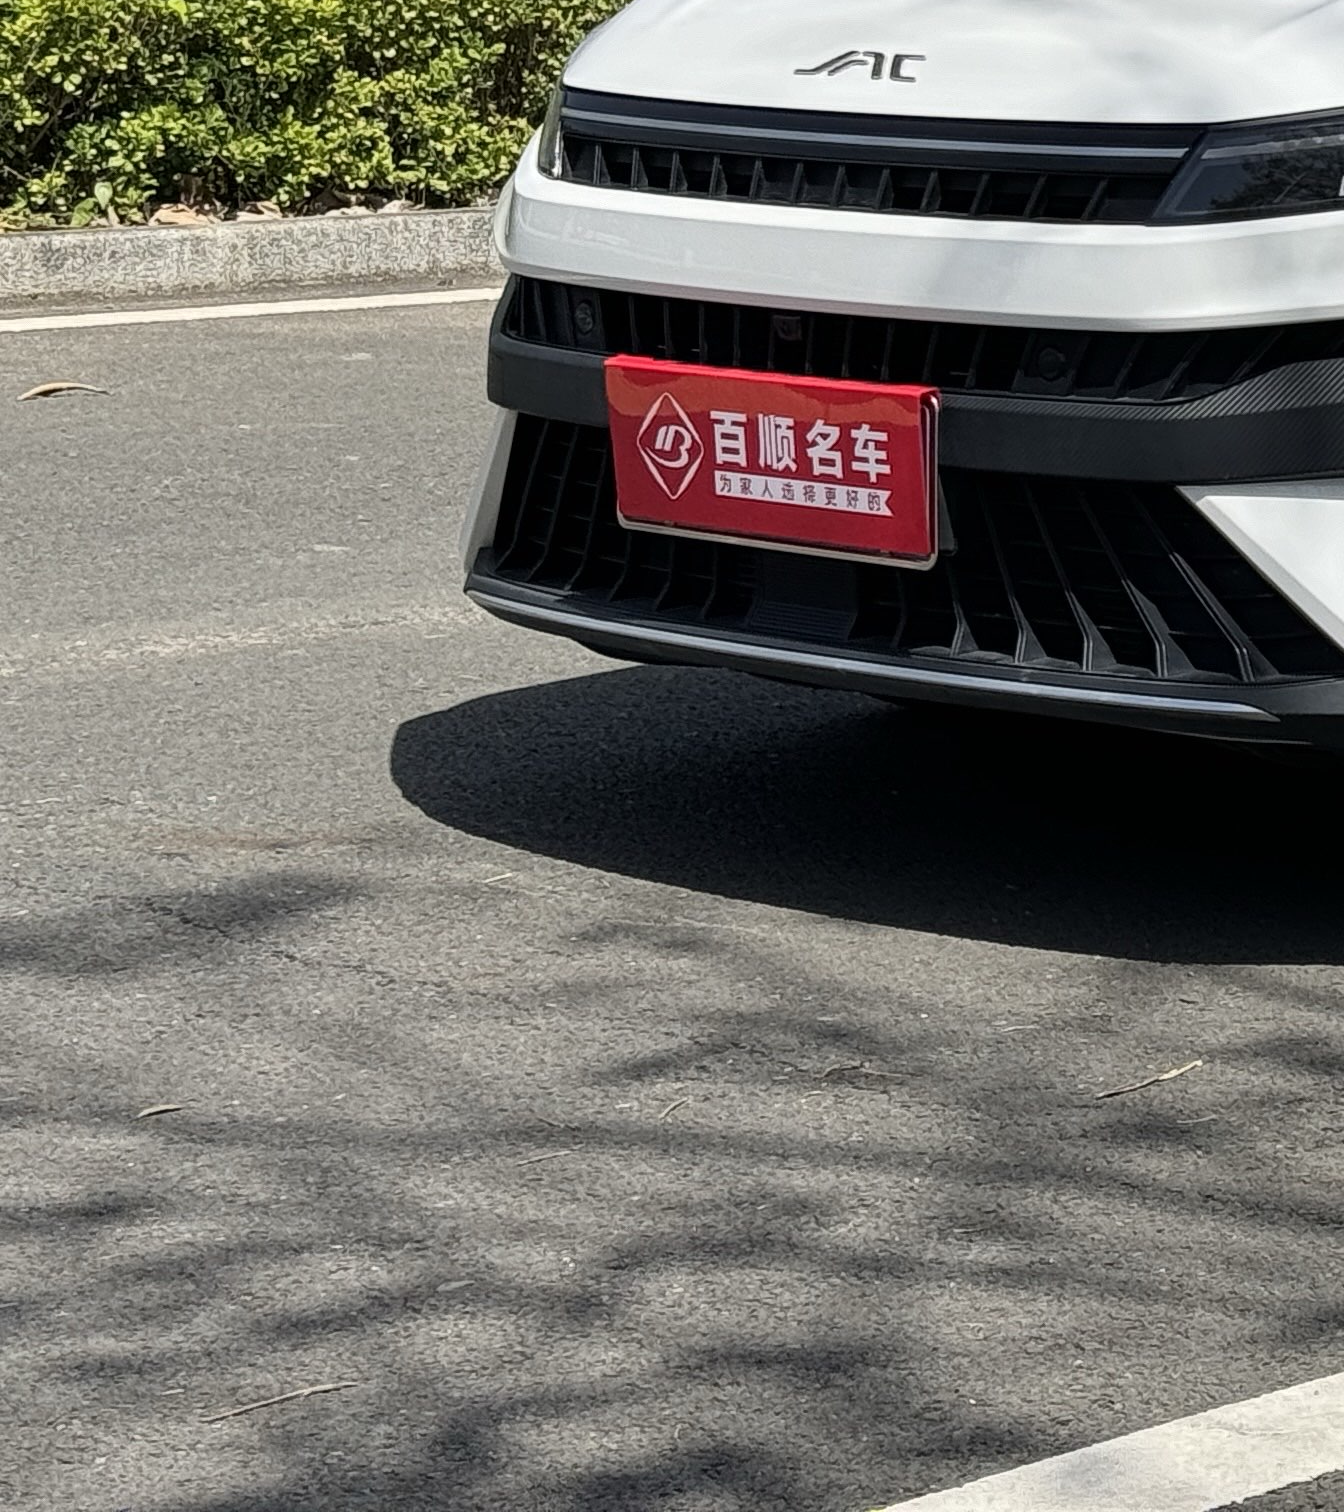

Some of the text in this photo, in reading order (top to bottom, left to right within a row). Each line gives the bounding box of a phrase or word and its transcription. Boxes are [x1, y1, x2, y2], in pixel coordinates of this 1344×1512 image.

[793, 50, 927, 83] JAC
[709, 409, 892, 484] 百顺名车
[719, 473, 882, 512] 为家人选择更好的
